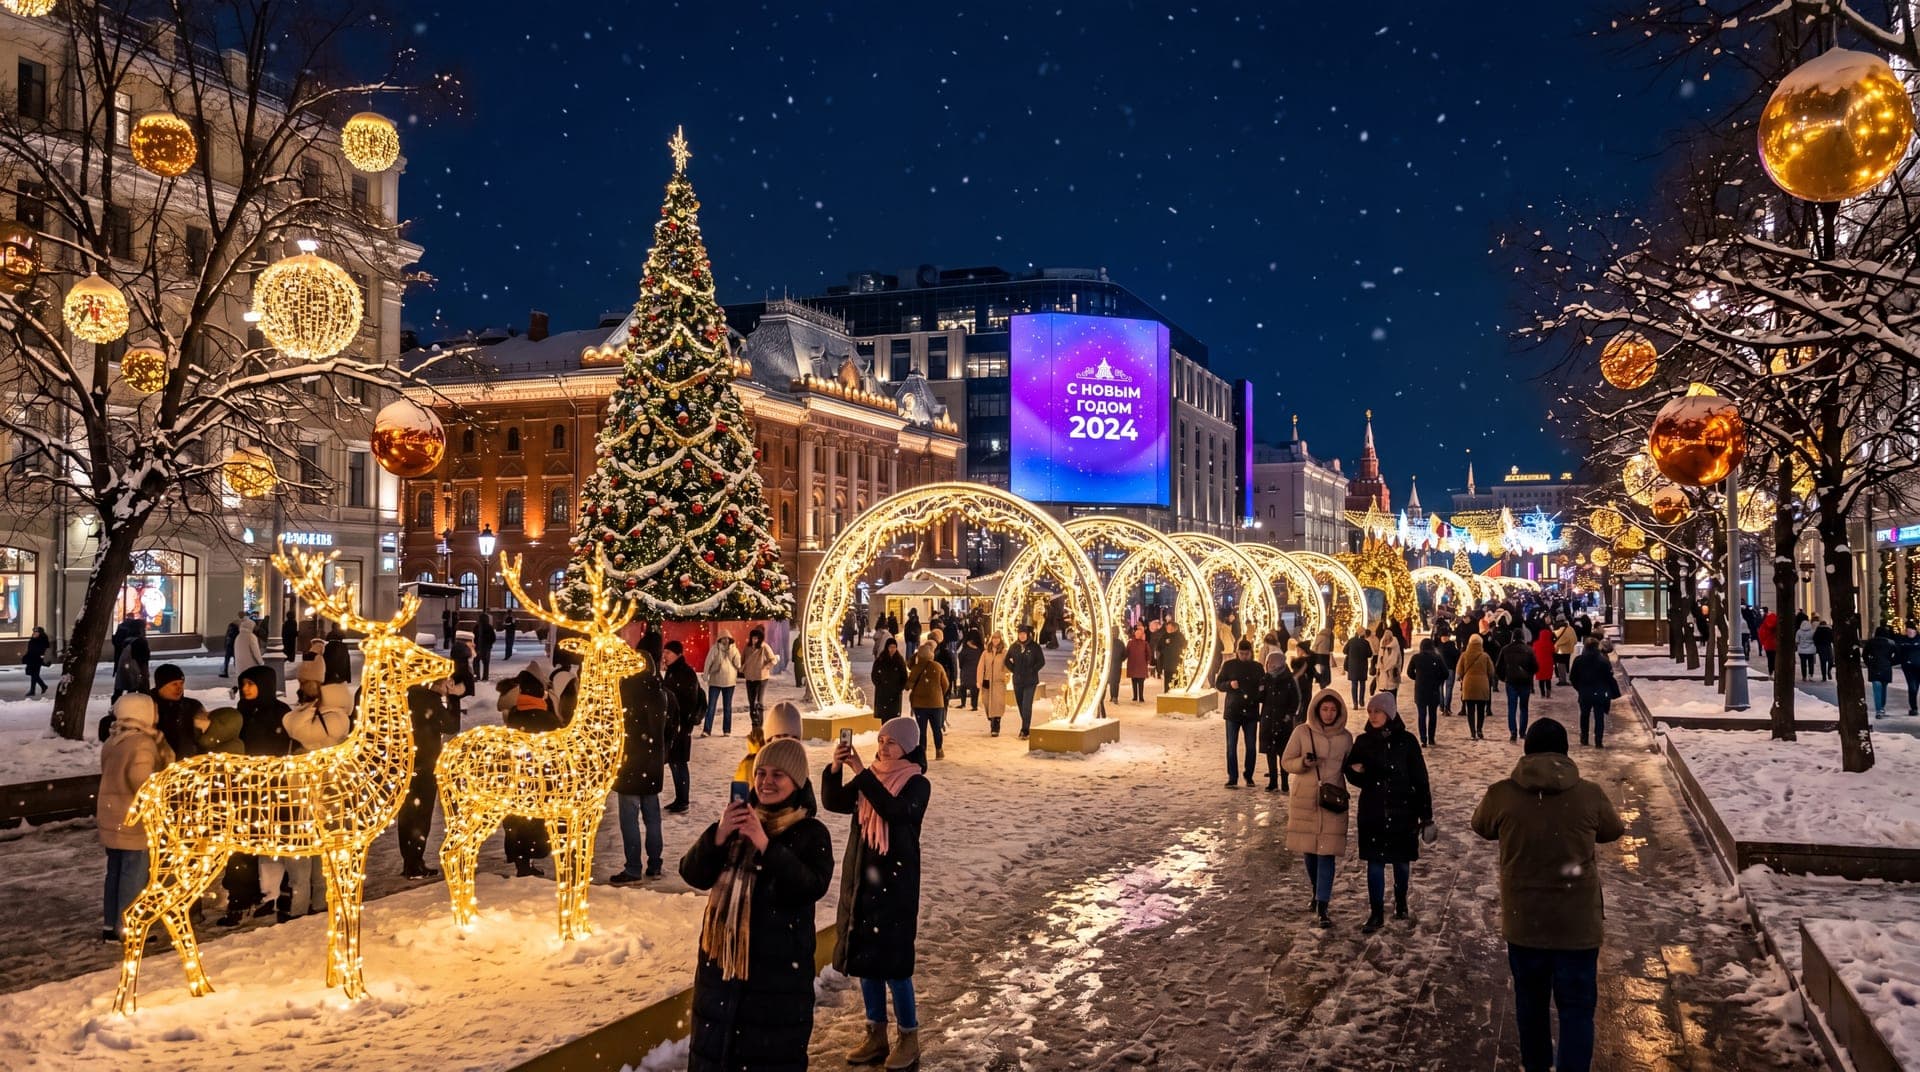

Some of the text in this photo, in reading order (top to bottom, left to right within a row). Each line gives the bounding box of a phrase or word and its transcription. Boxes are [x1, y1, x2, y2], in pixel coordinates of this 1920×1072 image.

[1067, 383, 1141, 399] С НОВЫМ
[1077, 400, 1132, 415] ГОДОМ
[1069, 415, 1138, 441] 2024
